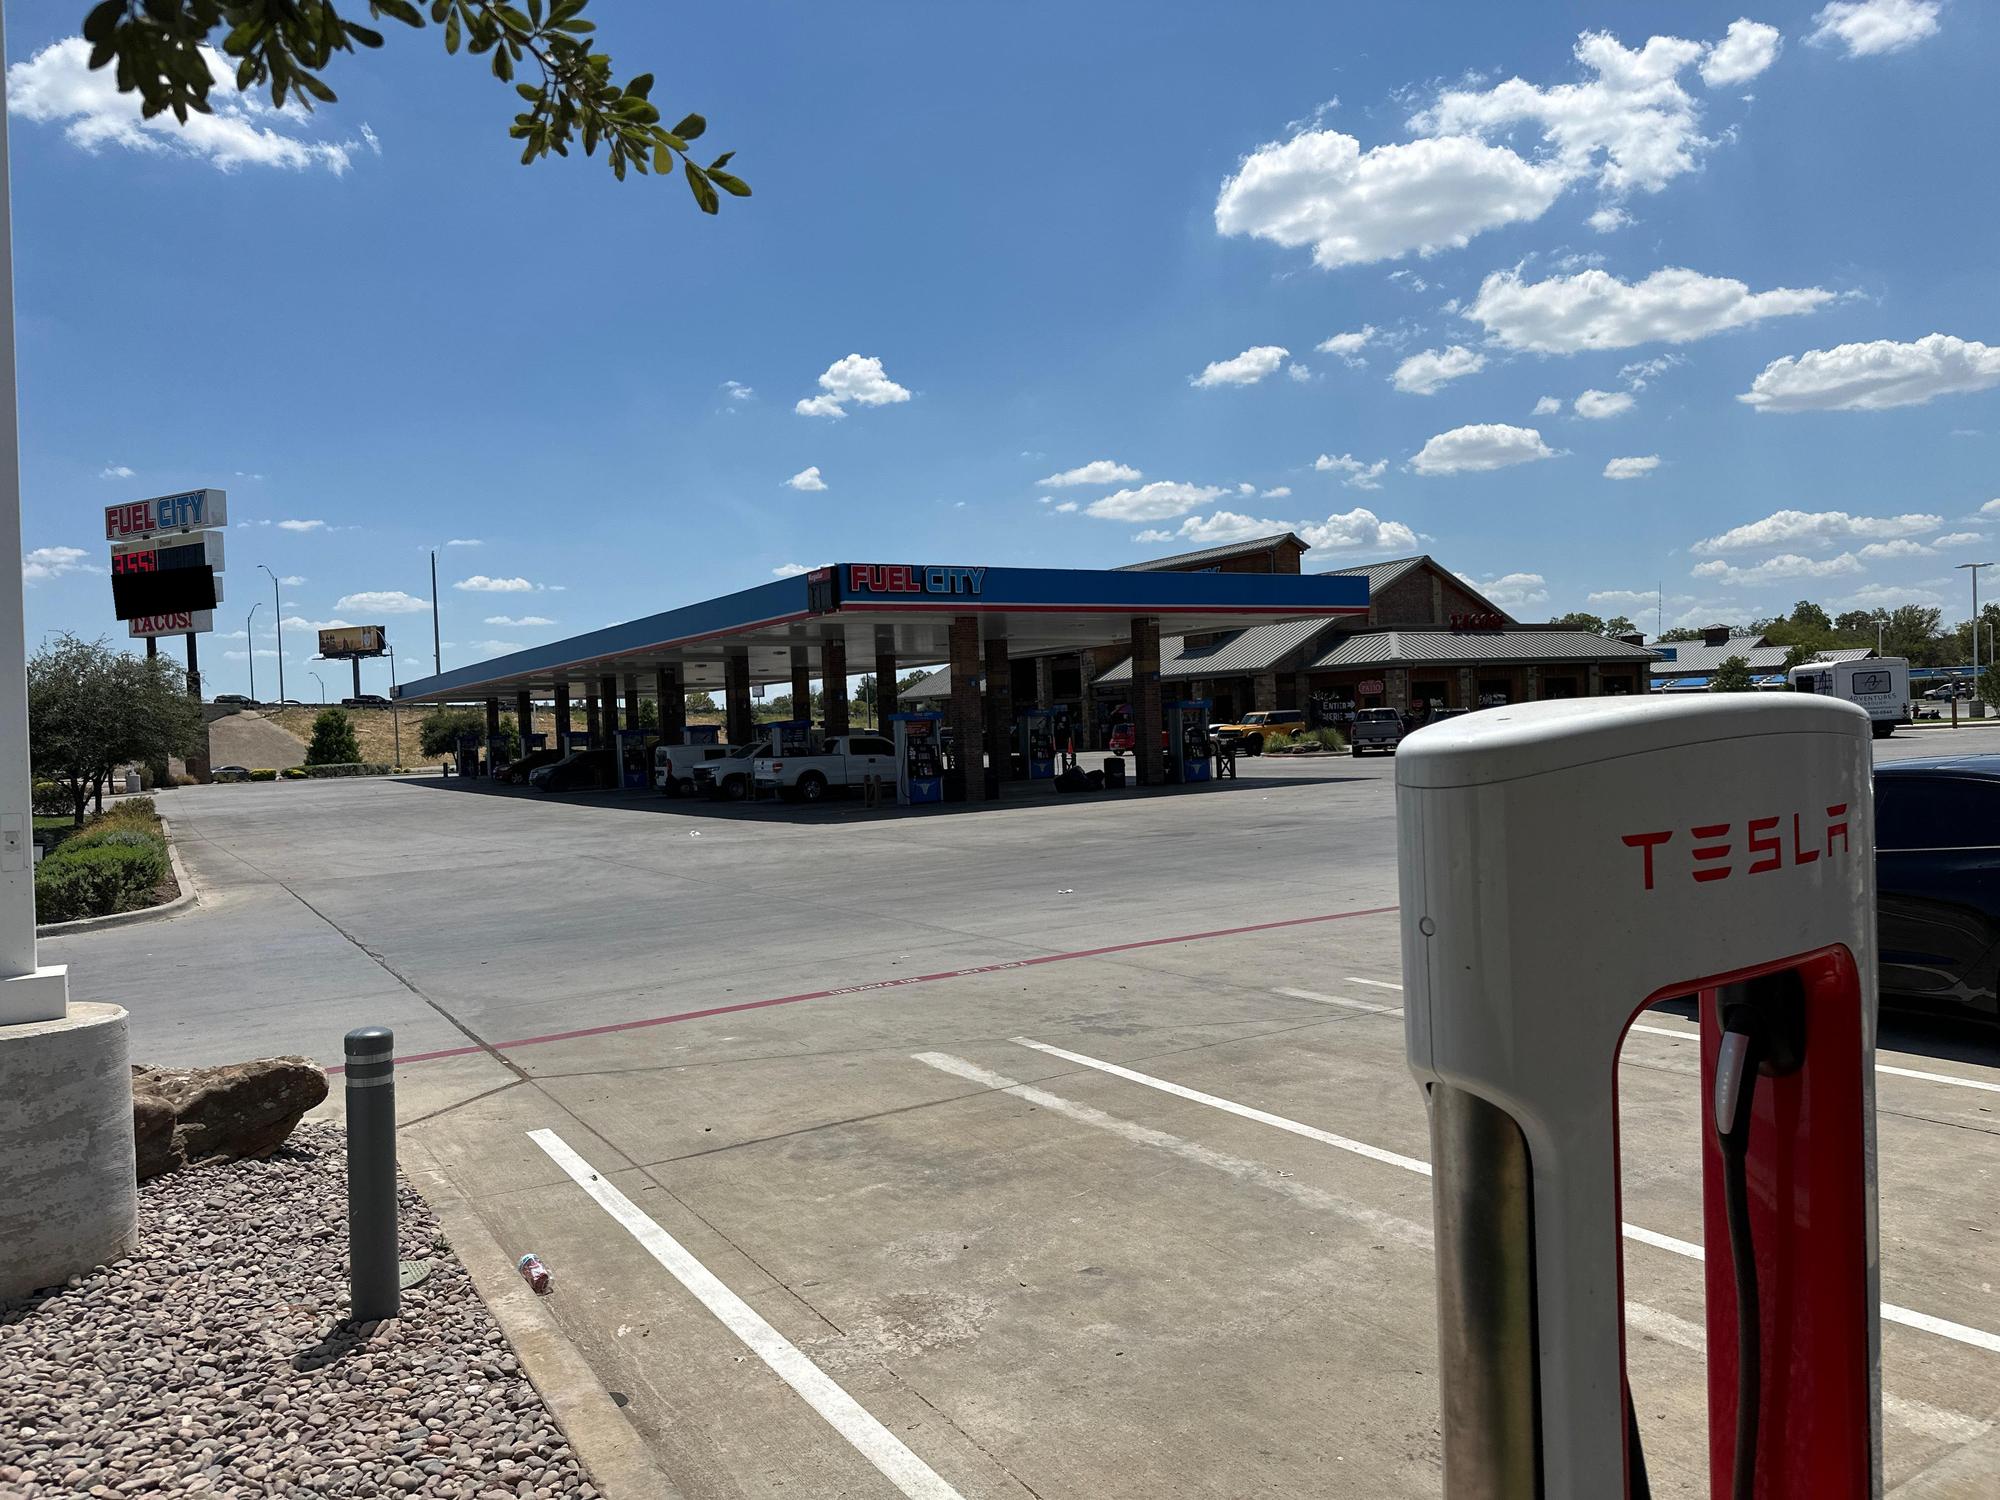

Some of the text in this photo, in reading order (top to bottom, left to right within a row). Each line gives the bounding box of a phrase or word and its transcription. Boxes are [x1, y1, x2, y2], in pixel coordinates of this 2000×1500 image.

[107, 491, 206, 539] FUEL CITY
[850, 564, 987, 594] FUEL CITY
[131, 611, 193, 634] TACOS!
[1849, 692, 1897, 702] ADVENTURES
[1621, 803, 1848, 890] TESLA
